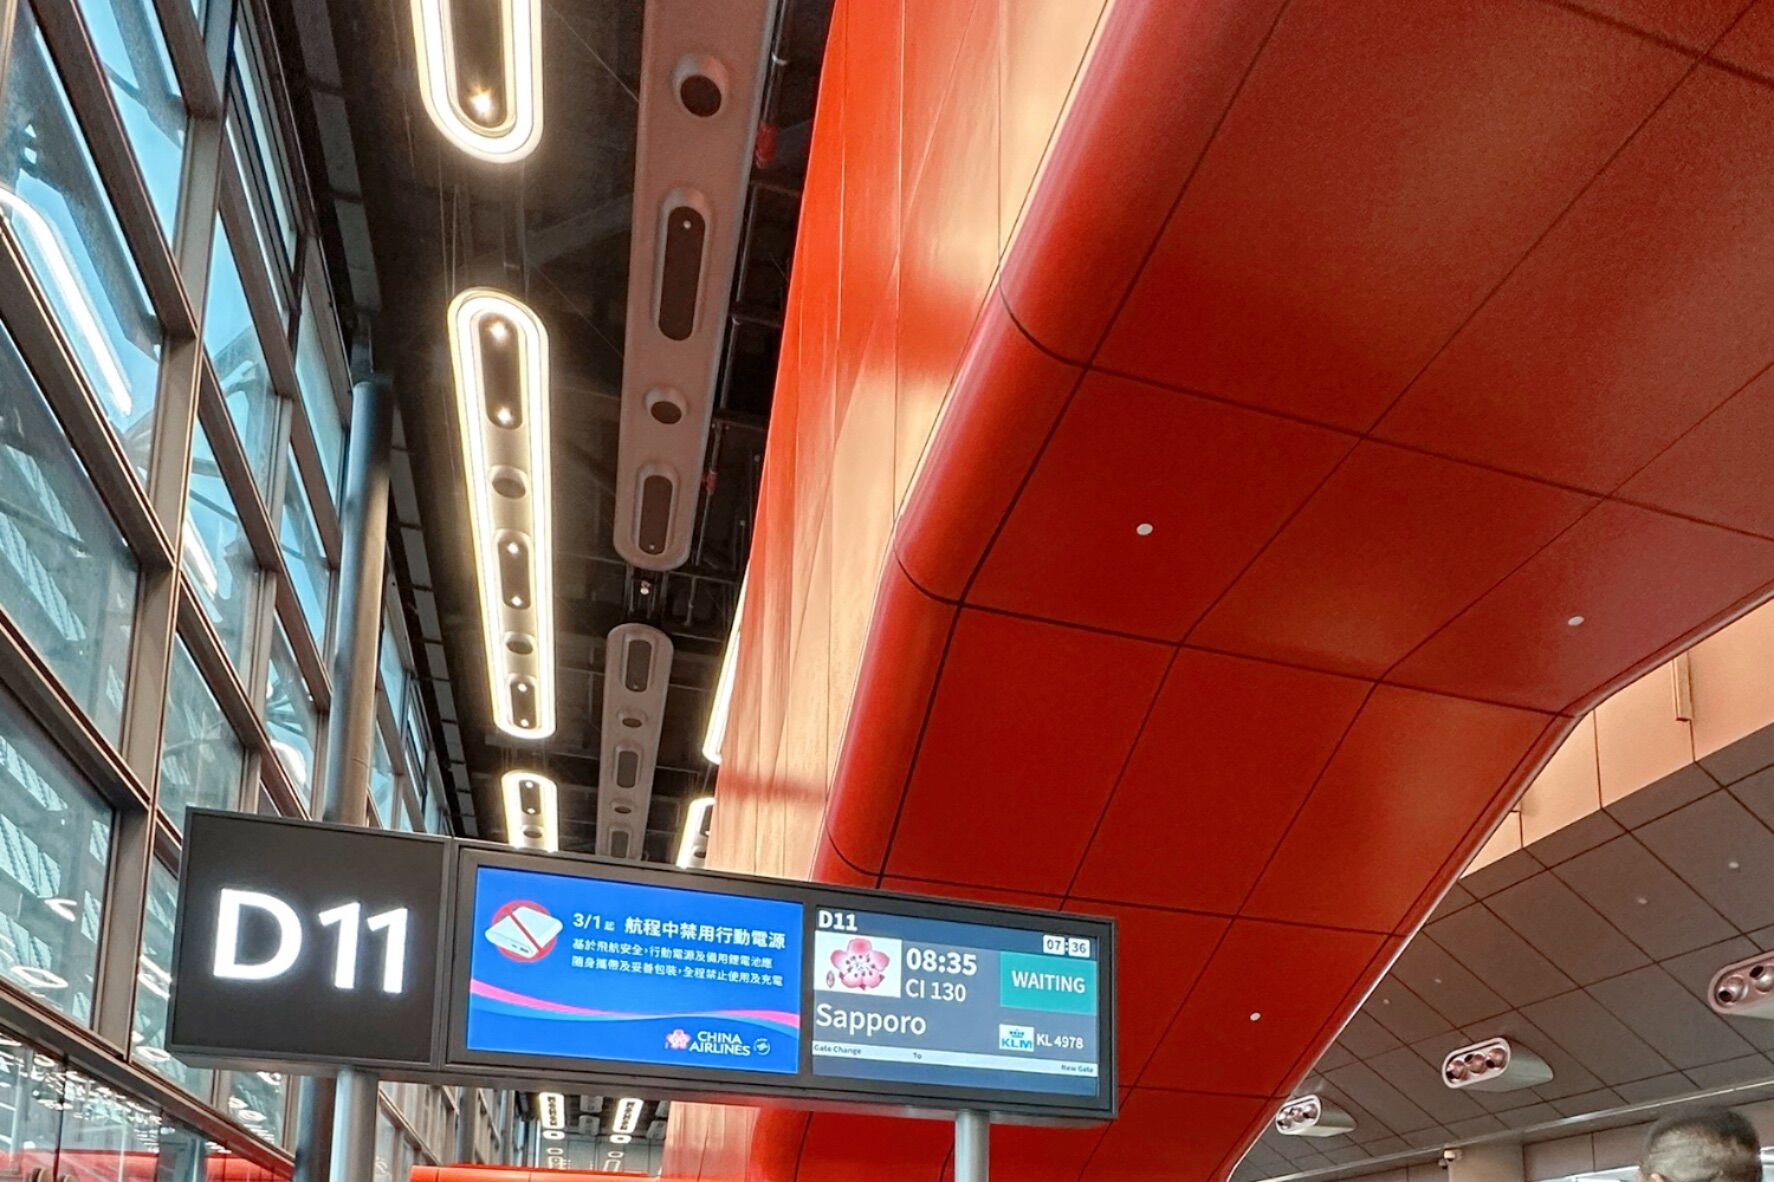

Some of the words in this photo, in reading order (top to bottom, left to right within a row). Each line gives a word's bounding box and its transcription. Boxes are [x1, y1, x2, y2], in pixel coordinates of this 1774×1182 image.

[818, 909, 858, 932] D11
[212, 887, 408, 994] D11
[624, 916, 786, 950] 航程中禁用行動電源
[1045, 939, 1088, 955] 07:36
[906, 948, 978, 976] 08:35
[905, 979, 926, 999] CI
[930, 981, 967, 1003] 130
[1011, 970, 1086, 994] WAITING
[816, 1003, 927, 1037] Sapporo
[688, 1040, 752, 1057] AIRLINES
[697, 1030, 743, 1045] CHINA
[1001, 1038, 1032, 1049] KLM
[1036, 1033, 1053, 1047] KL
[1054, 1035, 1084, 1050] 4978
[814, 1044, 832, 1053] Gate
[833, 1046, 862, 1056] Change
[912, 1052, 923, 1060] To
